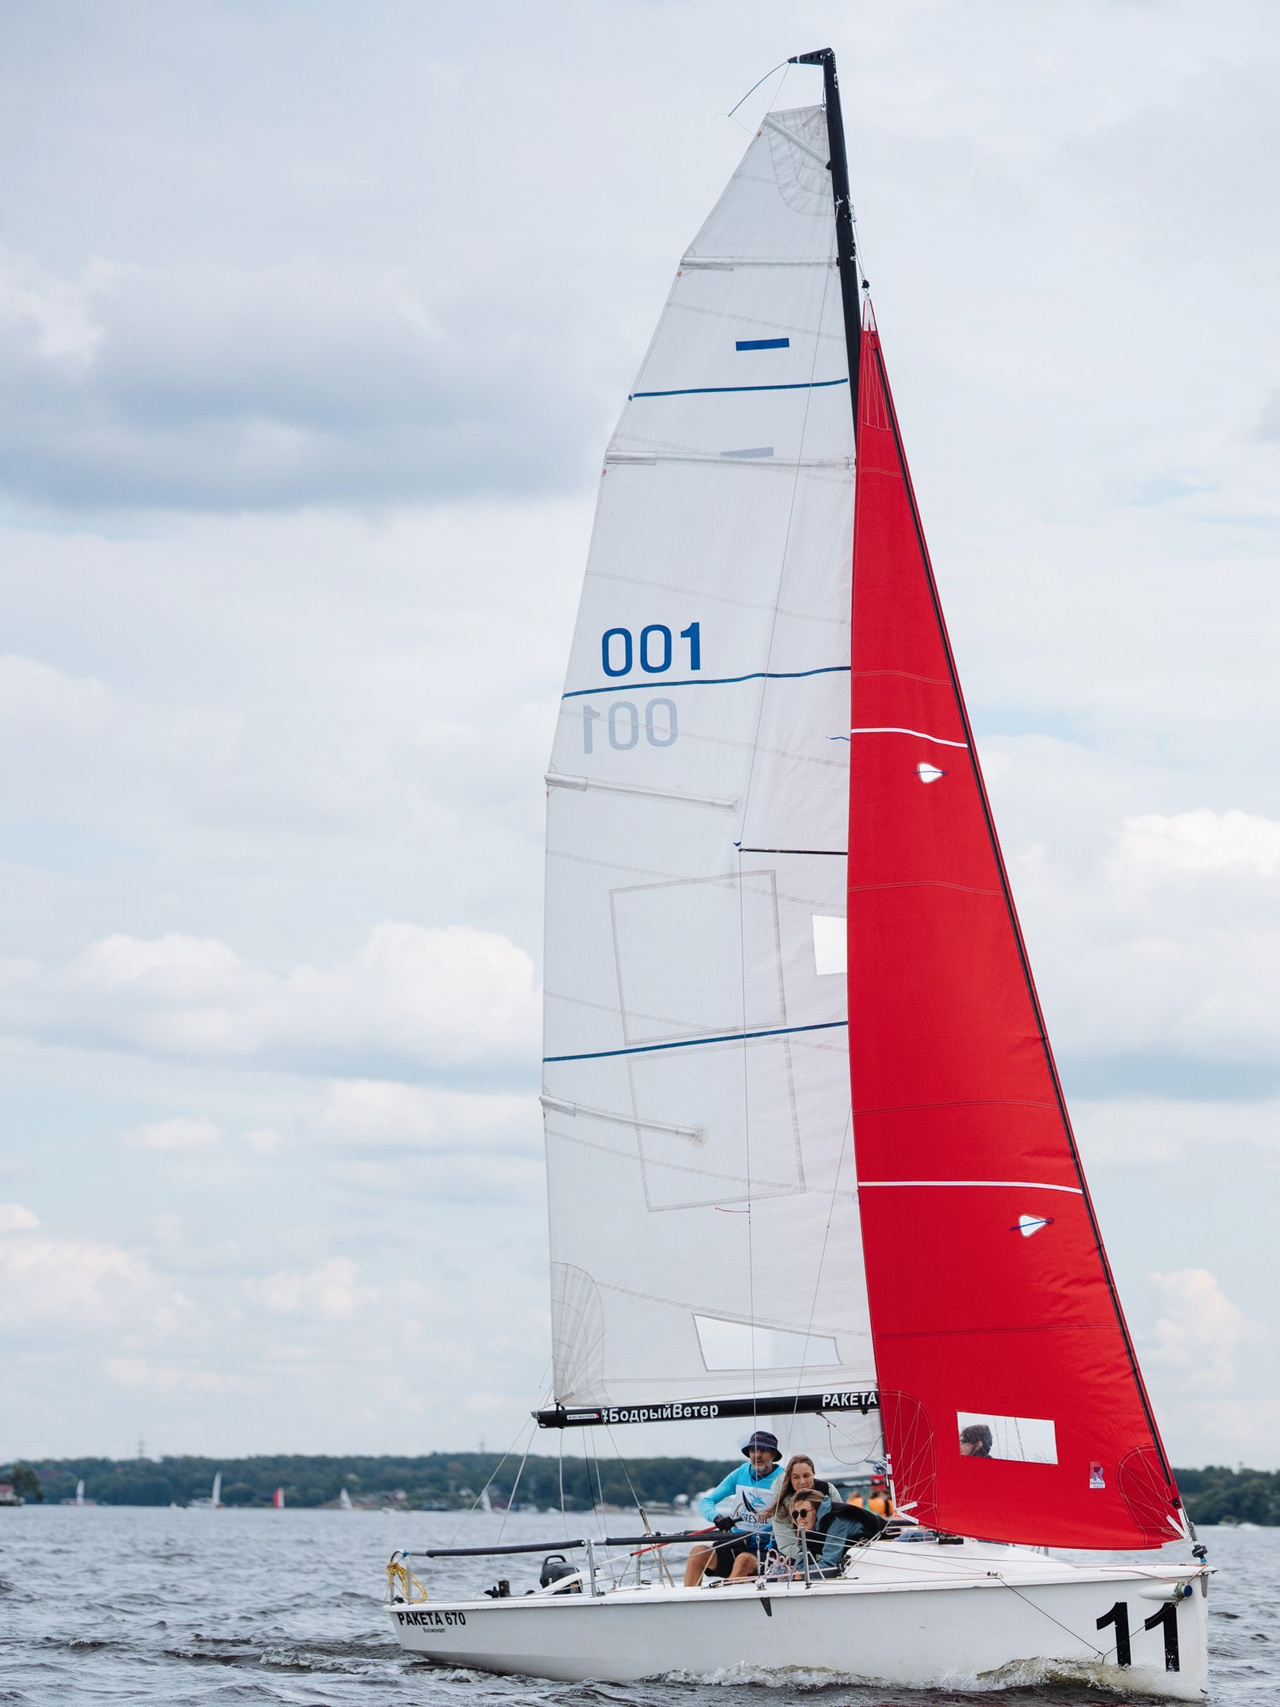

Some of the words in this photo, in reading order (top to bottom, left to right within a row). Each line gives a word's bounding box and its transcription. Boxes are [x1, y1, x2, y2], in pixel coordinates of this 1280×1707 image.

[602, 622, 701, 677] 001
[822, 1391, 878, 1407] РАКЕТА
[397, 1612, 443, 1625] РАКЕТА
[444, 1612, 466, 1625] 670
[1096, 1602, 1180, 1672] 11
